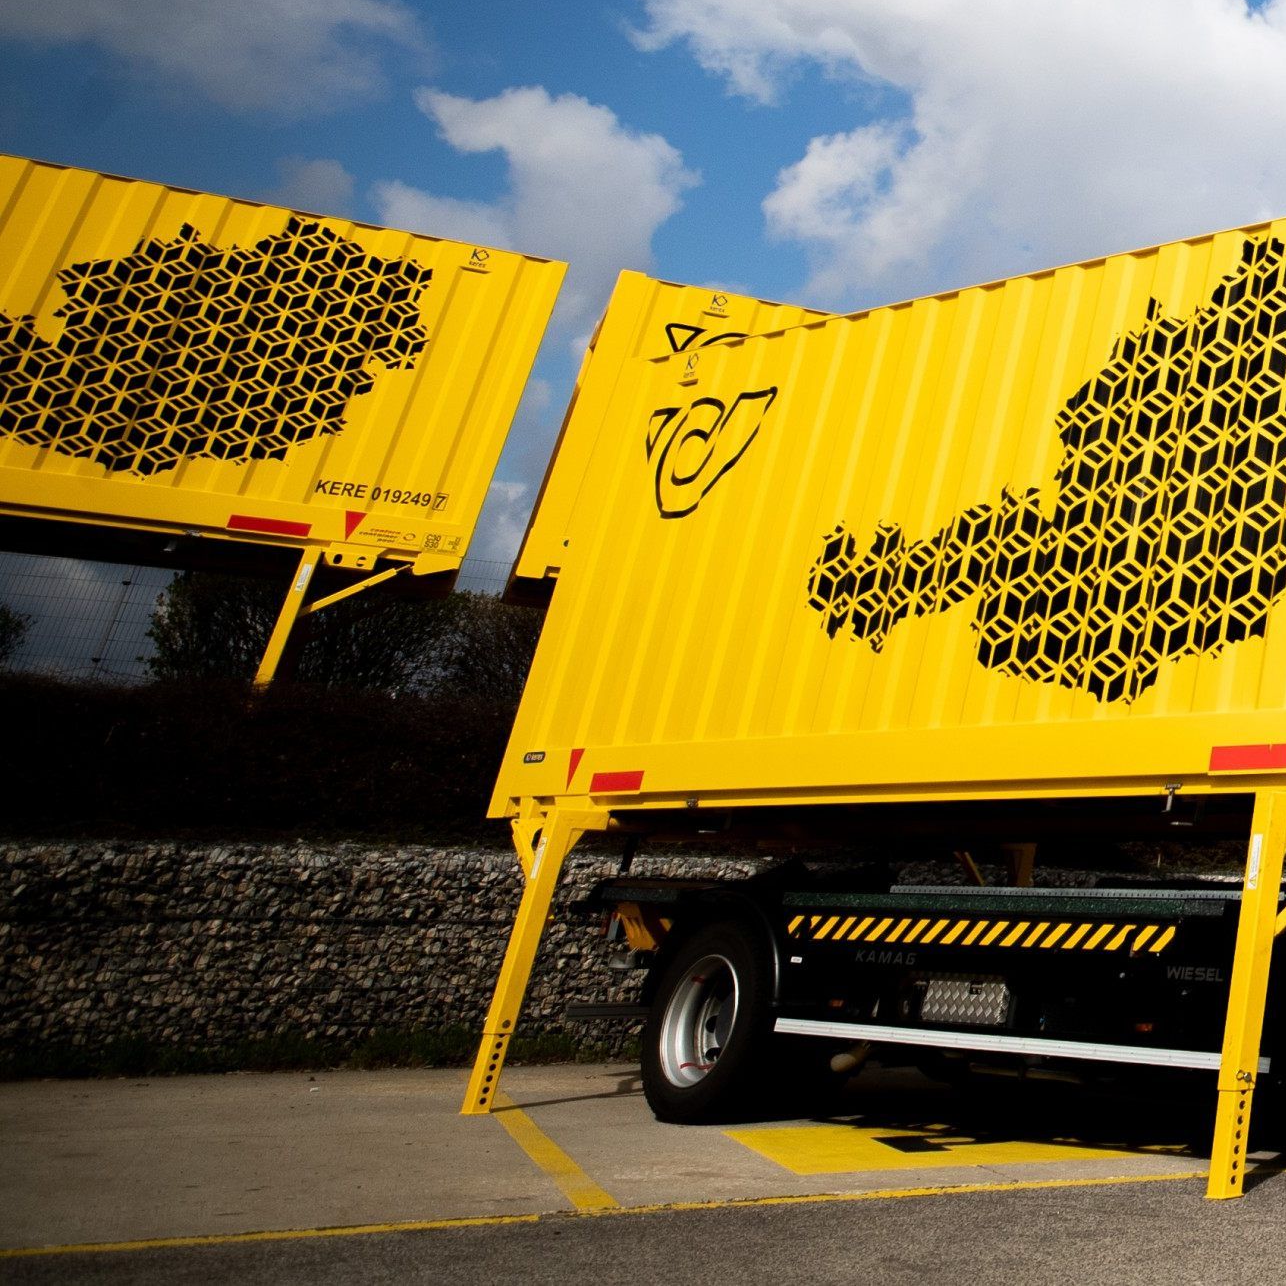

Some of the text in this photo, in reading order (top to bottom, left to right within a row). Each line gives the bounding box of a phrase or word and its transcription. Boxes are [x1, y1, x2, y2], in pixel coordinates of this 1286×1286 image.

[315, 479, 447, 509] KERE 019249 7
[855, 950, 917, 965] KAMAG
[1167, 965, 1223, 982] WIESEL
